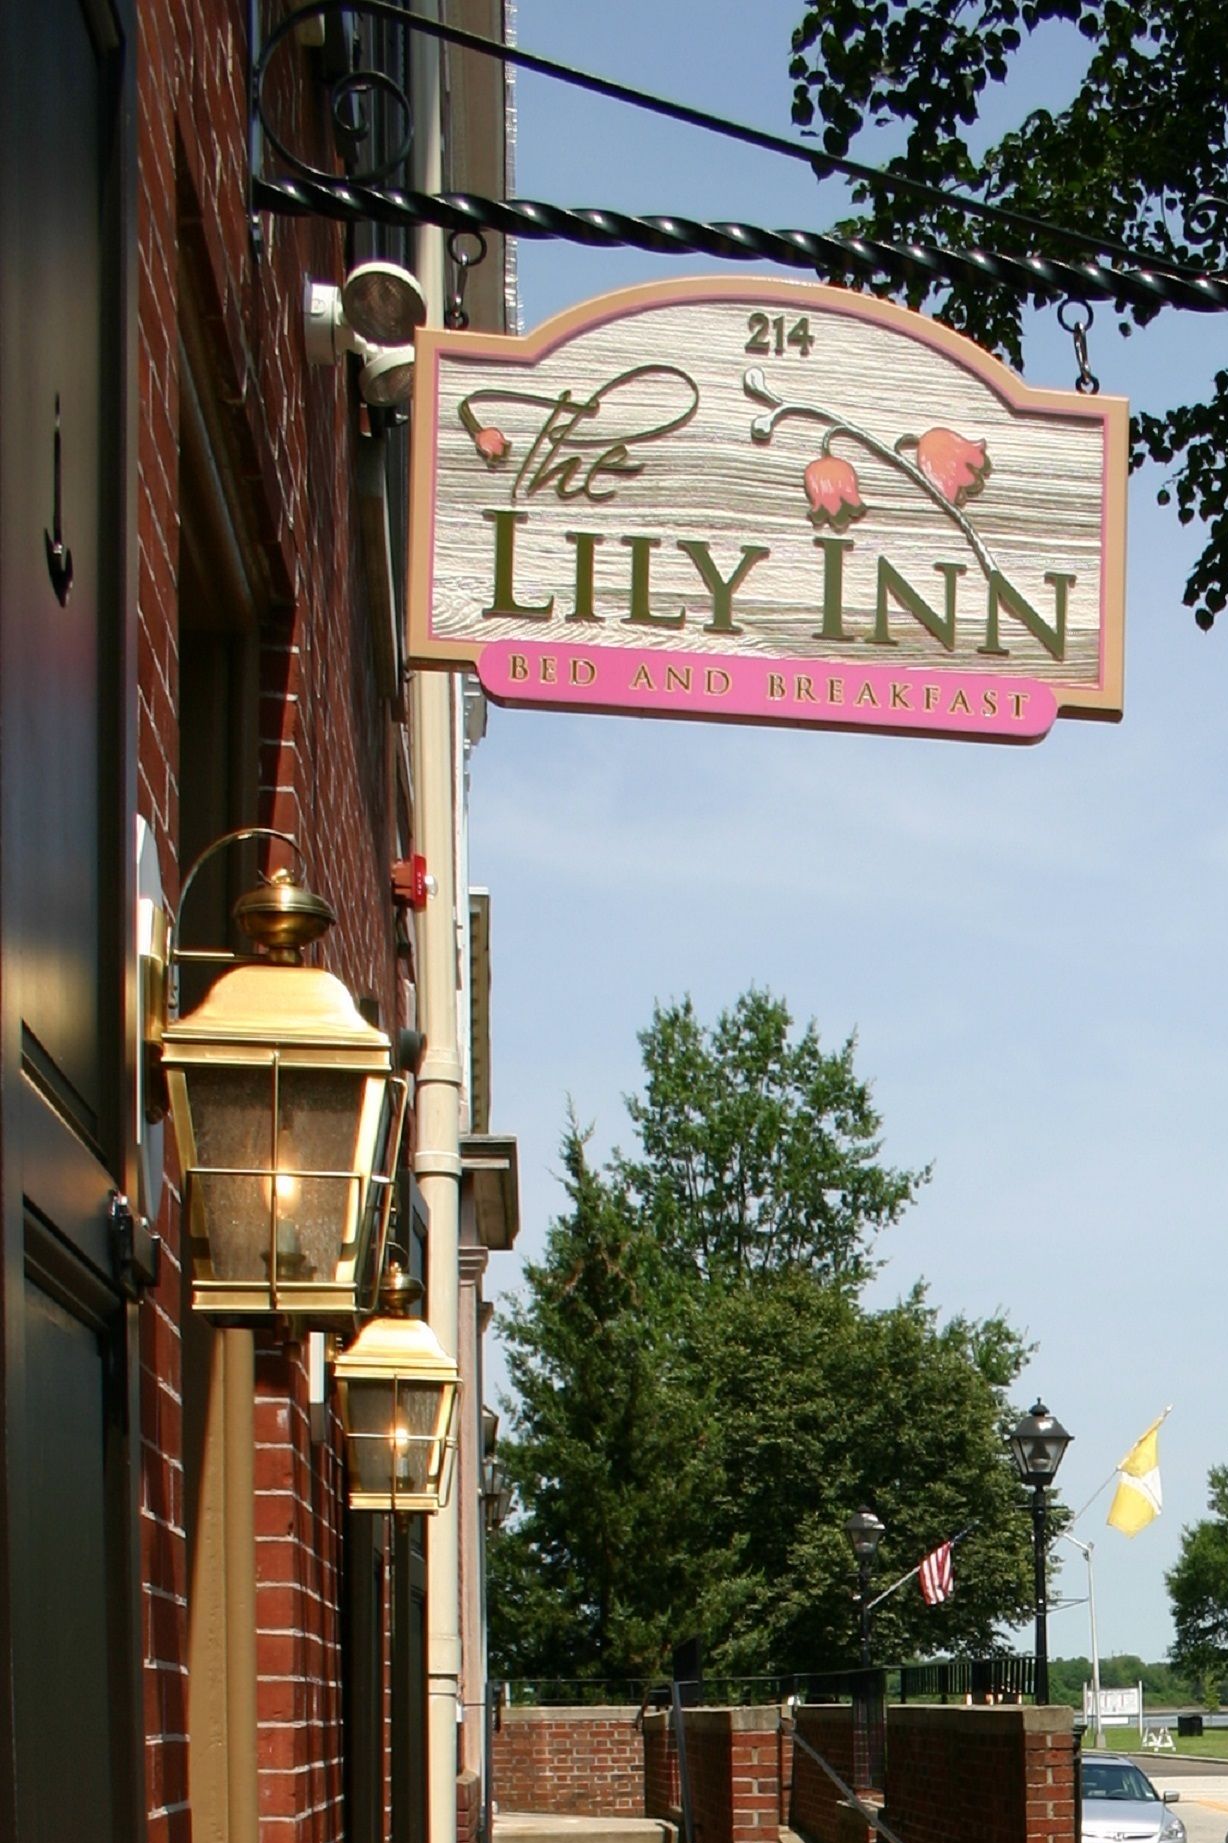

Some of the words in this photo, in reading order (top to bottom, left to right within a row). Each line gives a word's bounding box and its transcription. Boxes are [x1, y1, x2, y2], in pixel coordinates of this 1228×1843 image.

[744, 311, 815, 356] 214
[457, 363, 700, 502] The
[481, 507, 770, 635] LILY
[811, 535, 1077, 662] INN
[509, 653, 598, 687] BED
[631, 663, 732, 697] AND
[767, 672, 1032, 722] BREAKFAST
